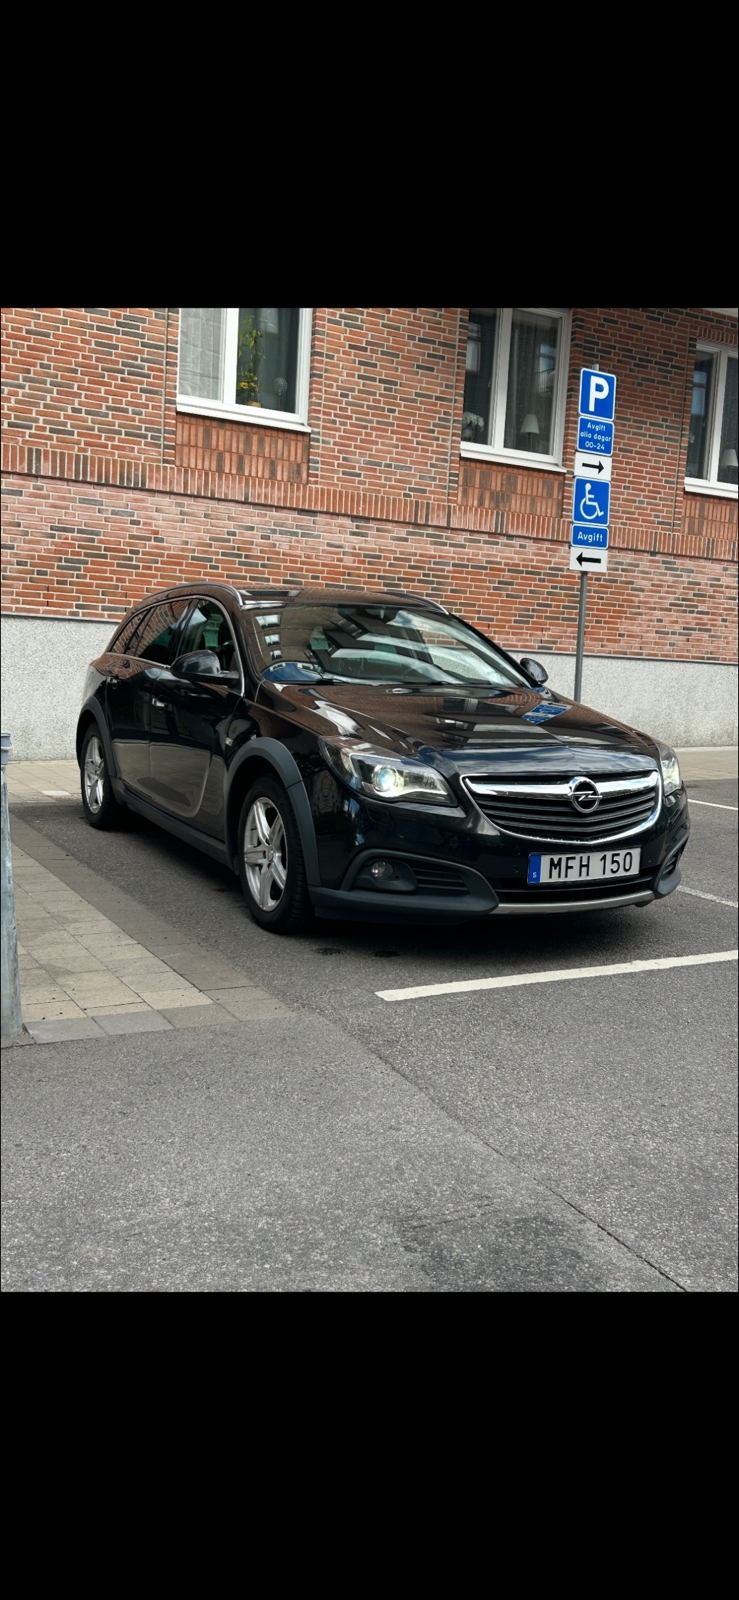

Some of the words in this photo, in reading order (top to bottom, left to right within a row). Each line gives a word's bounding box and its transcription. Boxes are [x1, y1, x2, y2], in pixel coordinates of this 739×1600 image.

[589, 375, 609, 412] P
[587, 422, 606, 431] Avgift
[593, 433, 611, 442] dagar
[585, 441, 605, 450] 00-24
[577, 531, 603, 543] Avgift
[549, 855, 591, 879] MFH
[600, 851, 633, 876] 150
